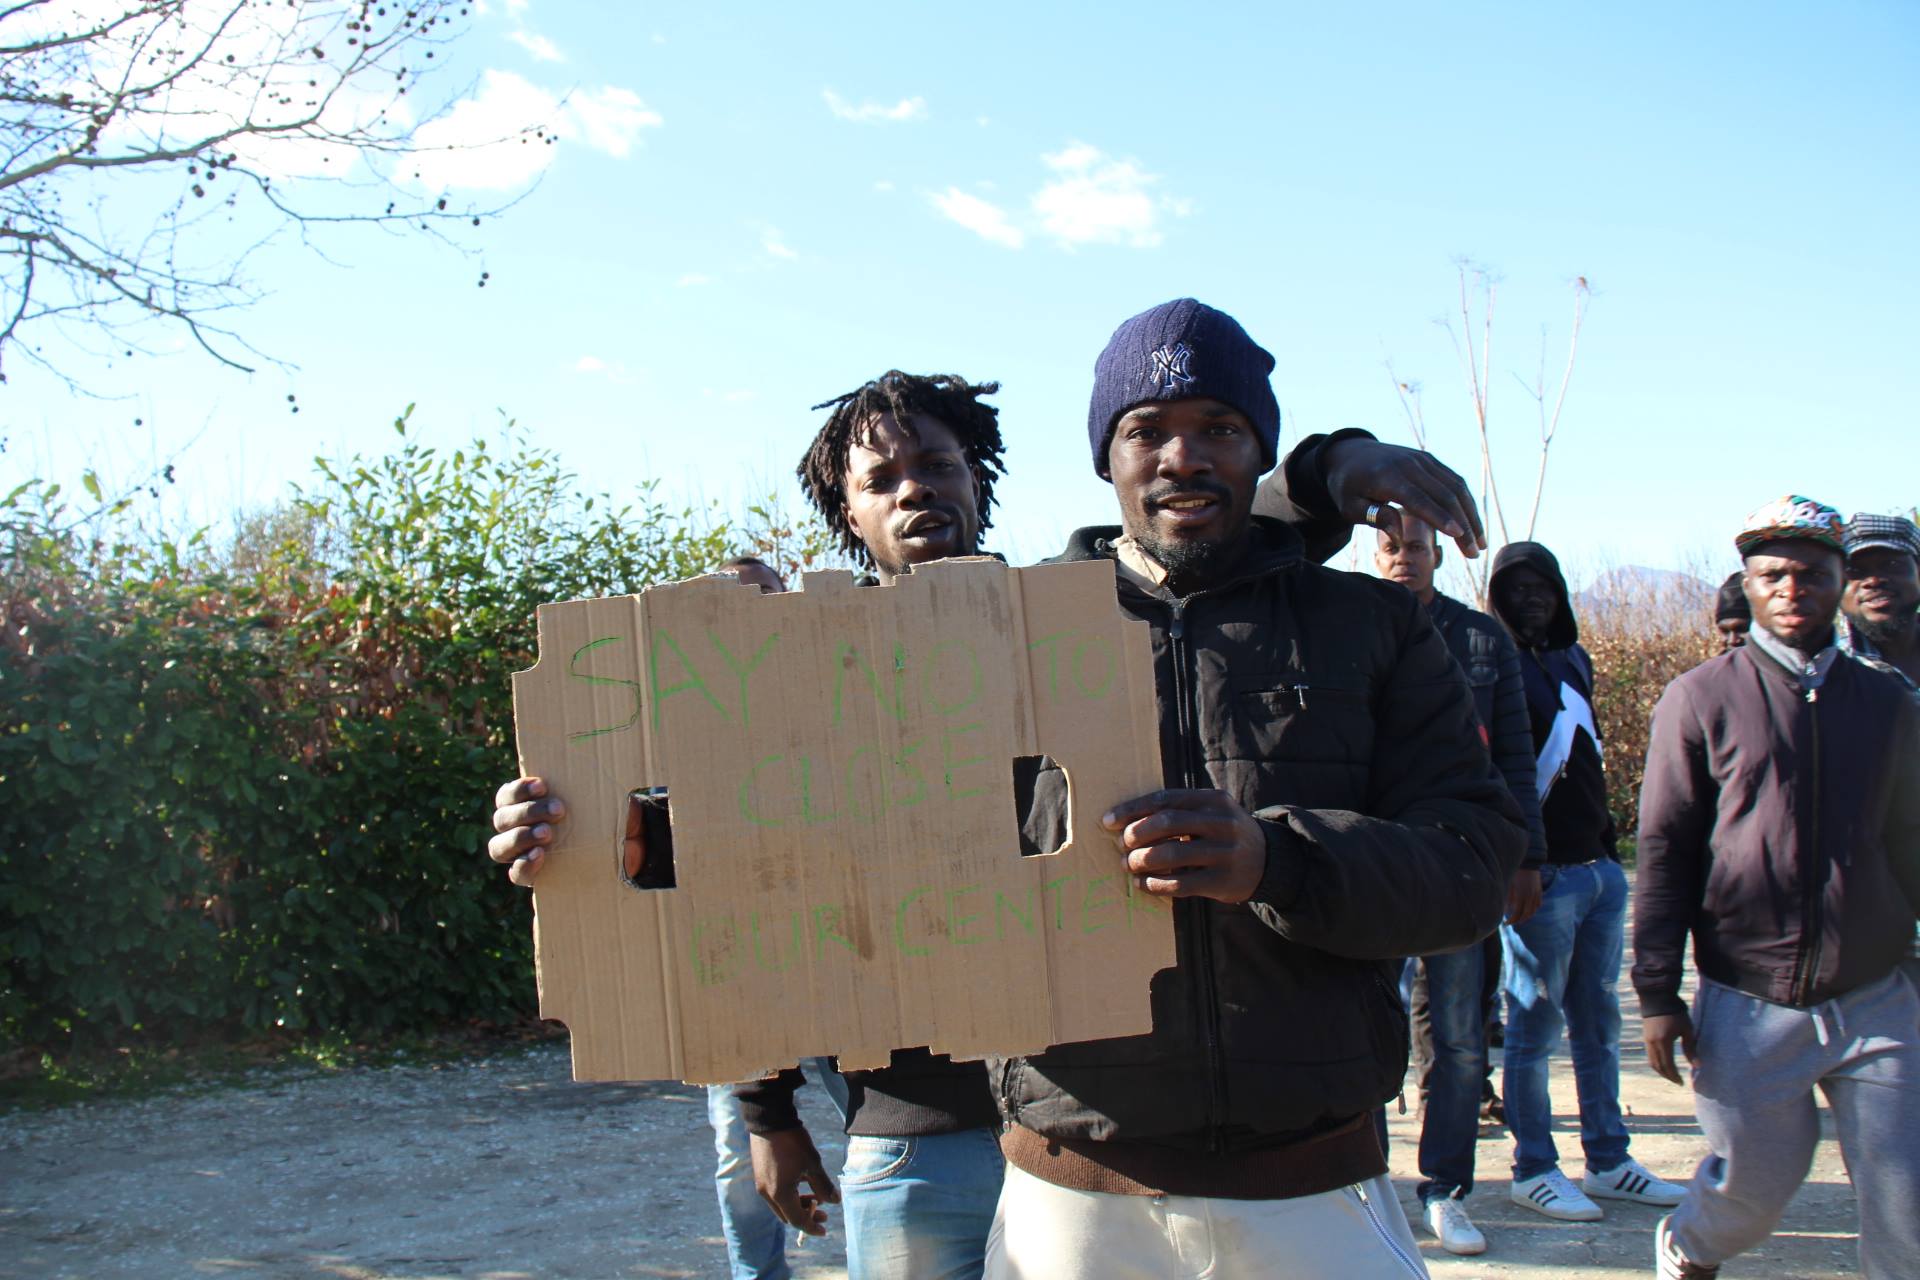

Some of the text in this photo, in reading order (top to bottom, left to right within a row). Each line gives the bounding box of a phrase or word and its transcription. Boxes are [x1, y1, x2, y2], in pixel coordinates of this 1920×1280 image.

[1150, 342, 1194, 388] NY
[567, 627, 1118, 747] SAY NO TO
[738, 720, 992, 827] CLOSE
[688, 902, 860, 987] OUR
